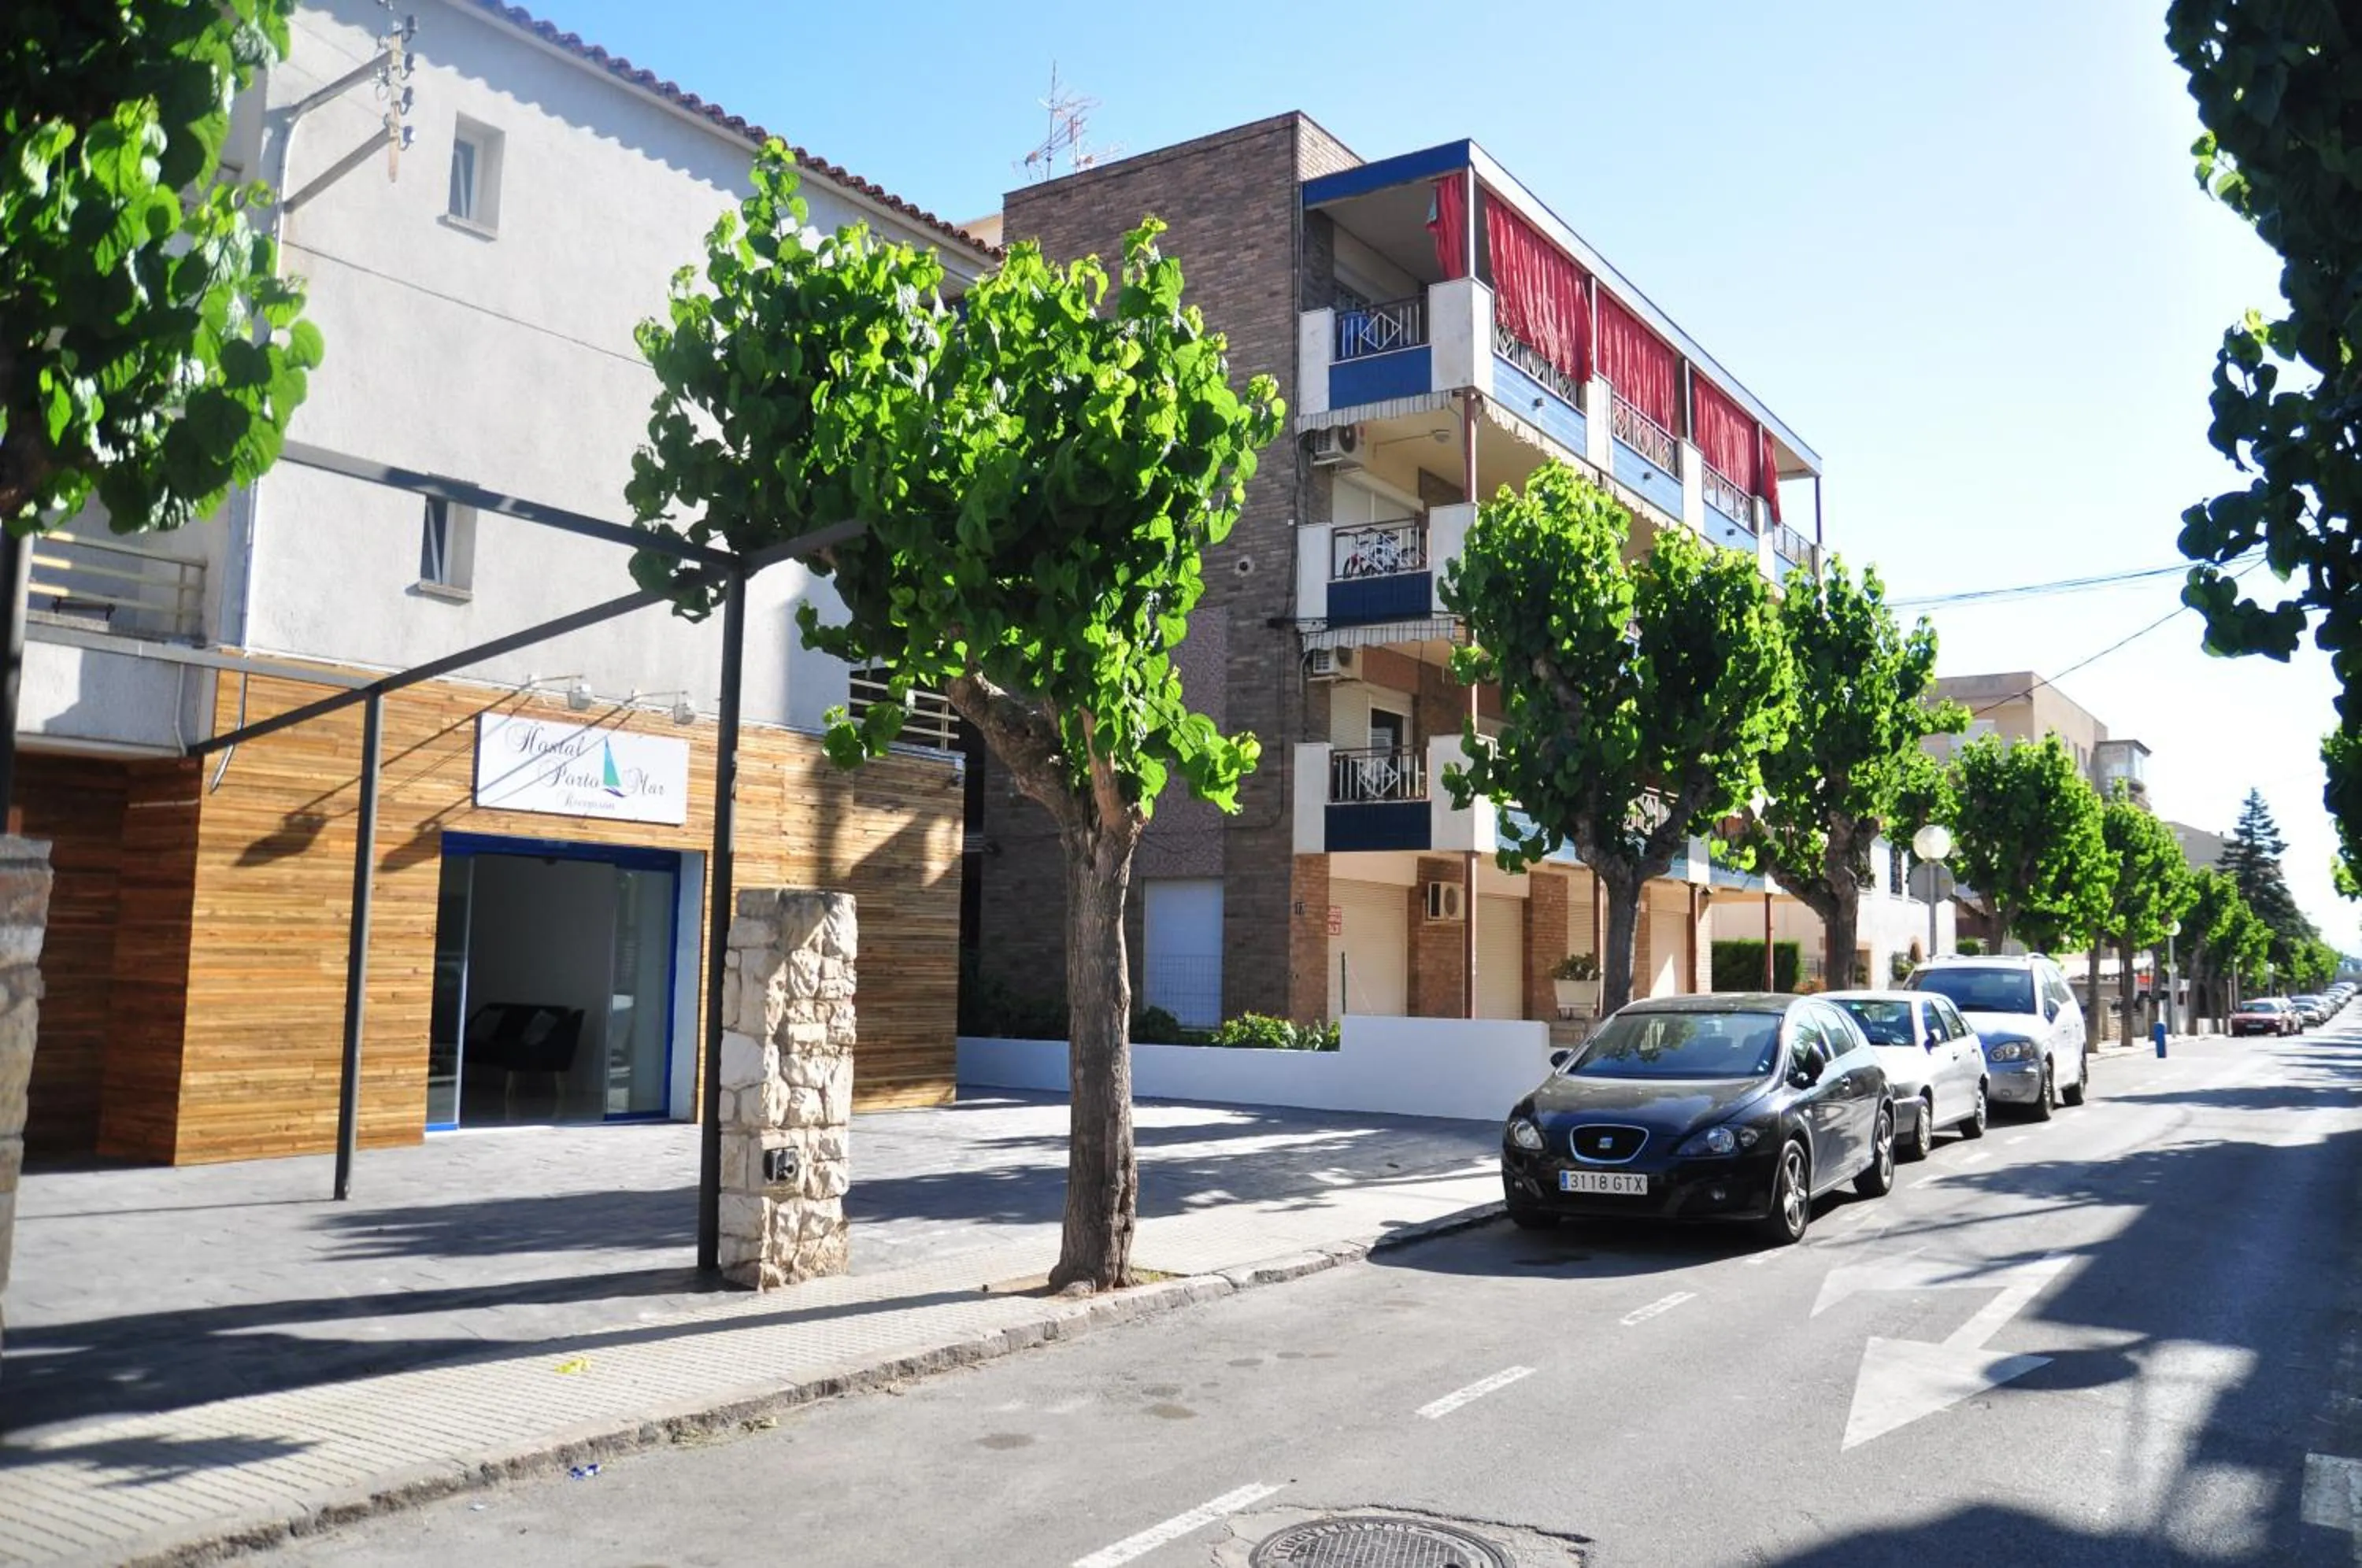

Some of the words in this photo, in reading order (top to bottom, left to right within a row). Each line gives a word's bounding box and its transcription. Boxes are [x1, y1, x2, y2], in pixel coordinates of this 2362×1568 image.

[505, 723, 585, 757] Hostal
[621, 767, 666, 797] Mar
[1570, 1174, 1608, 1190] 3118
[1613, 1175, 1643, 1193] GTX
